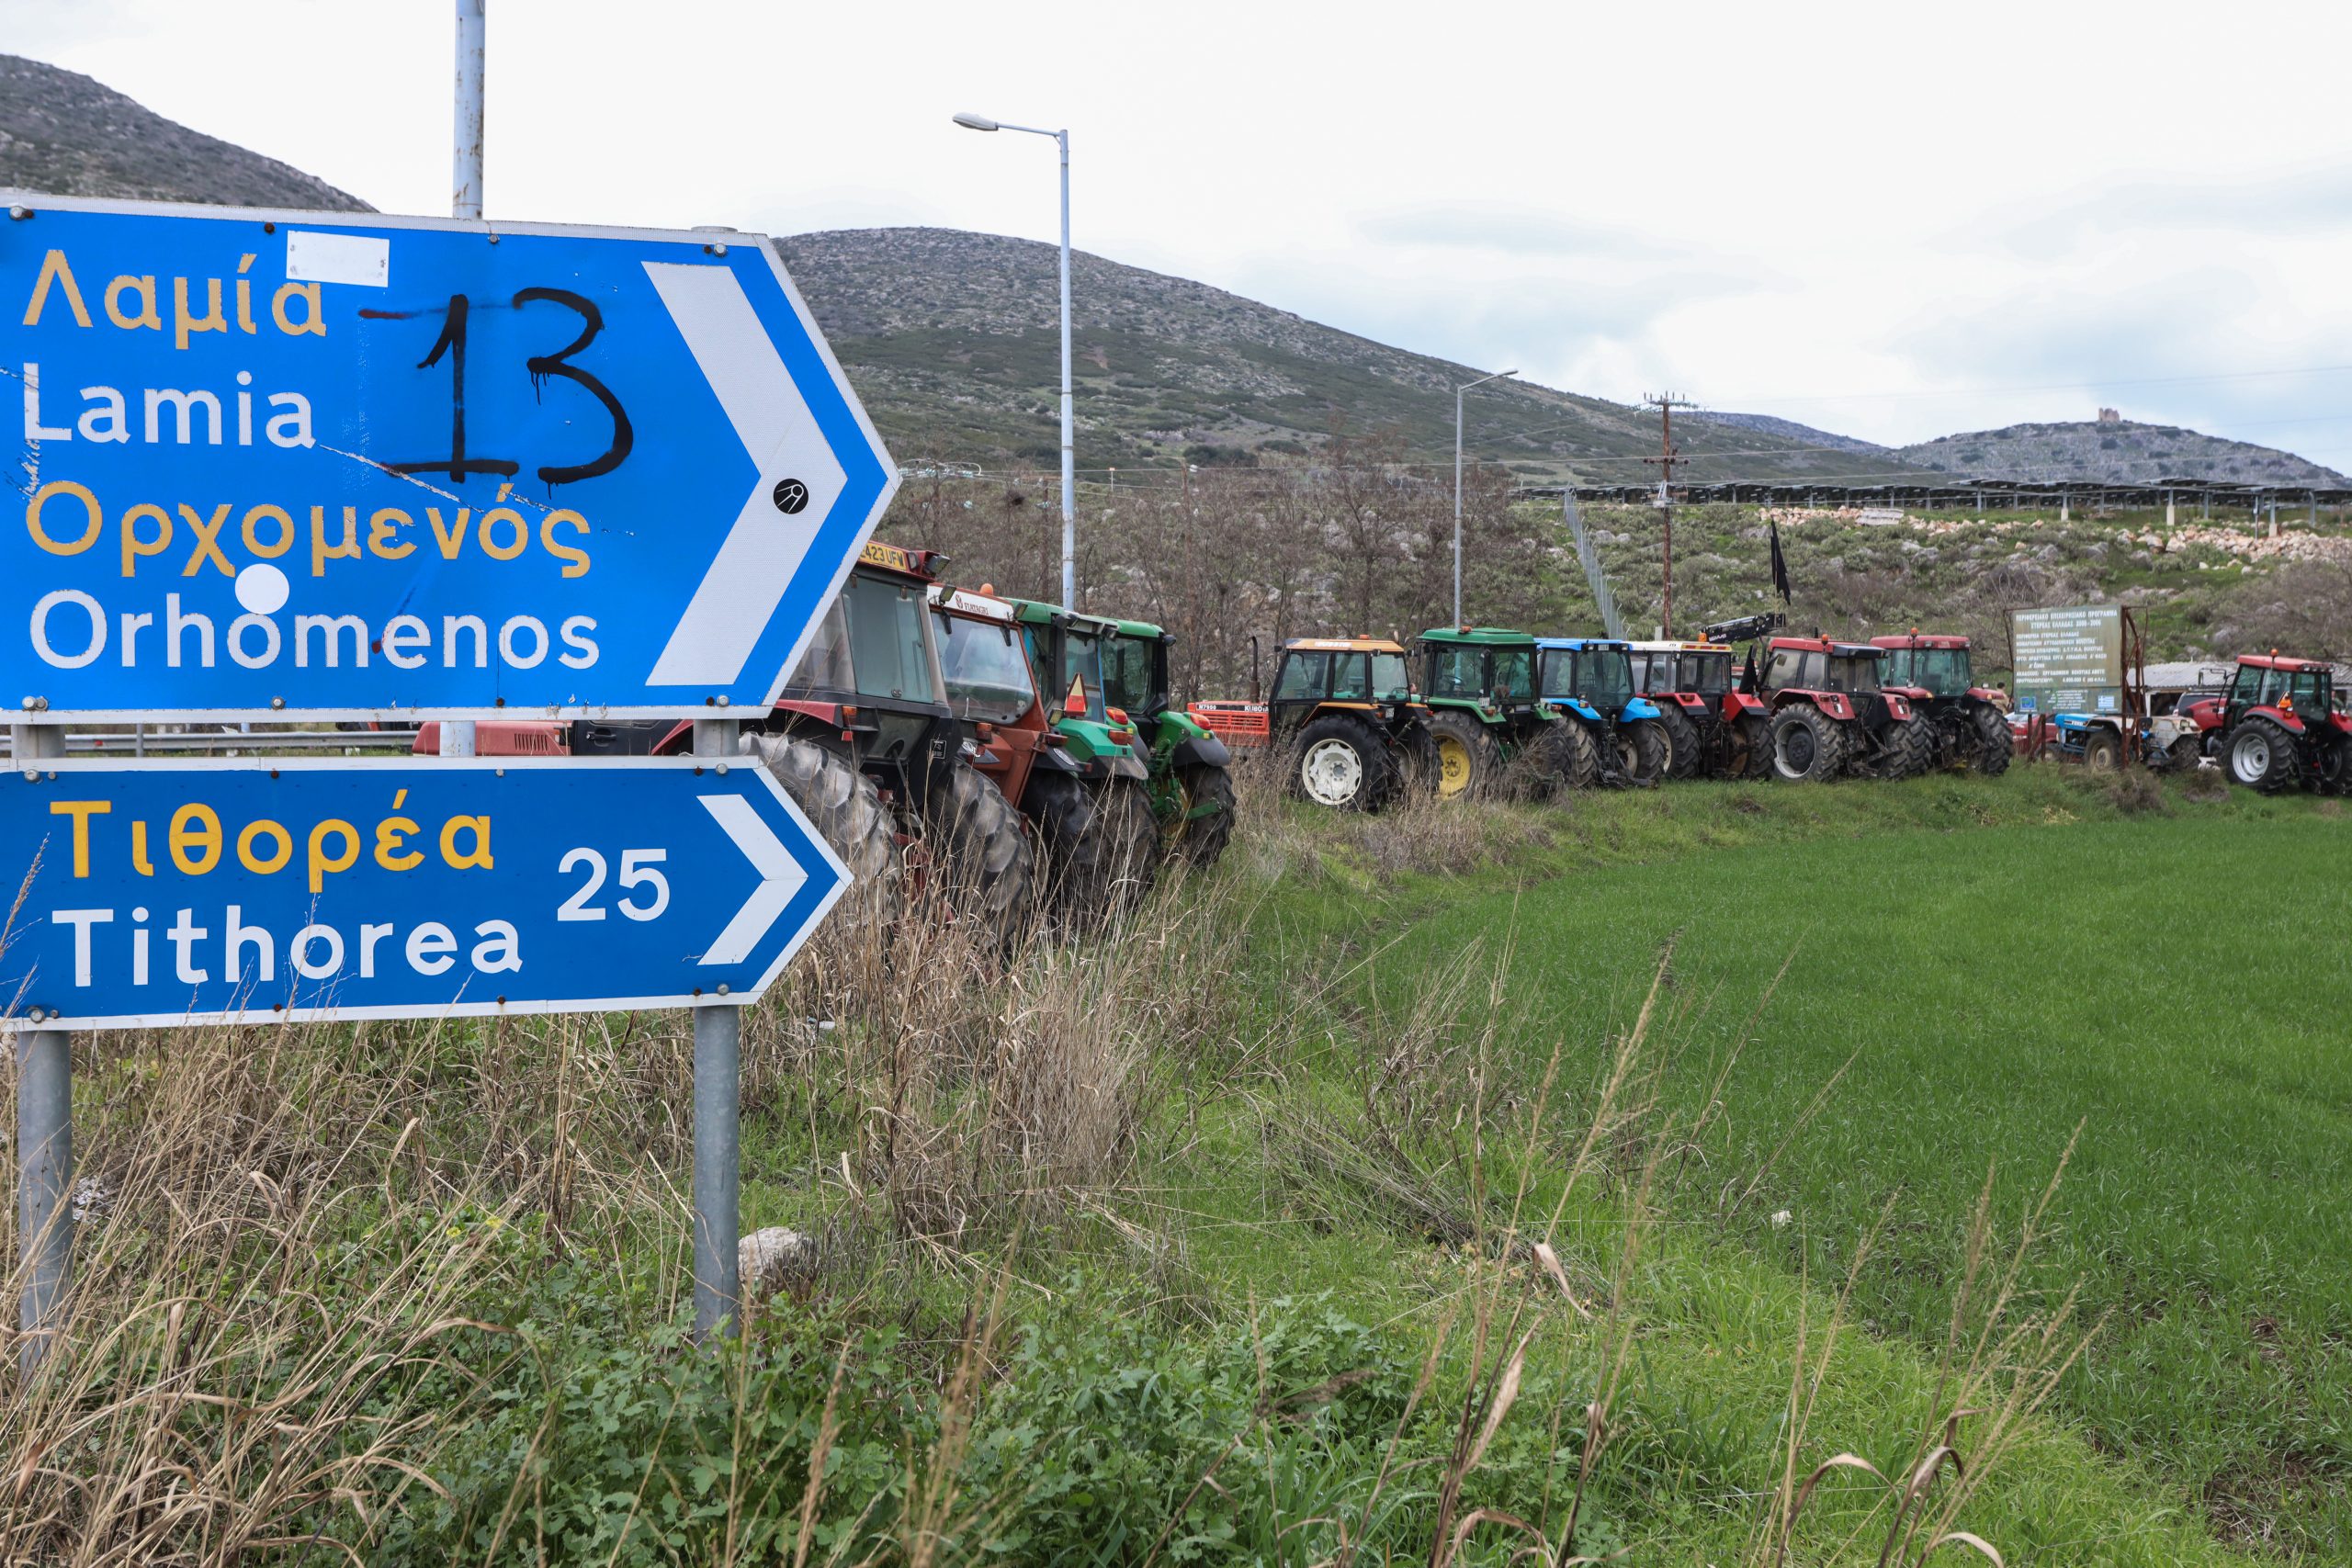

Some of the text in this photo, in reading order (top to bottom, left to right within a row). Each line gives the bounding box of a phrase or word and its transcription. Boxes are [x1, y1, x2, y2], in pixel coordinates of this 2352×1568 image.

[23, 249, 326, 350] Λαμία
[24, 363, 316, 448] Lamia
[379, 286, 635, 489] 13
[26, 480, 592, 579] Ορχομενός
[860, 545, 904, 567] 423 UFW
[29, 589, 600, 669] Orhomenos
[50, 789, 495, 893] Τιθορέα
[52, 846, 671, 987] Tithorea 25
